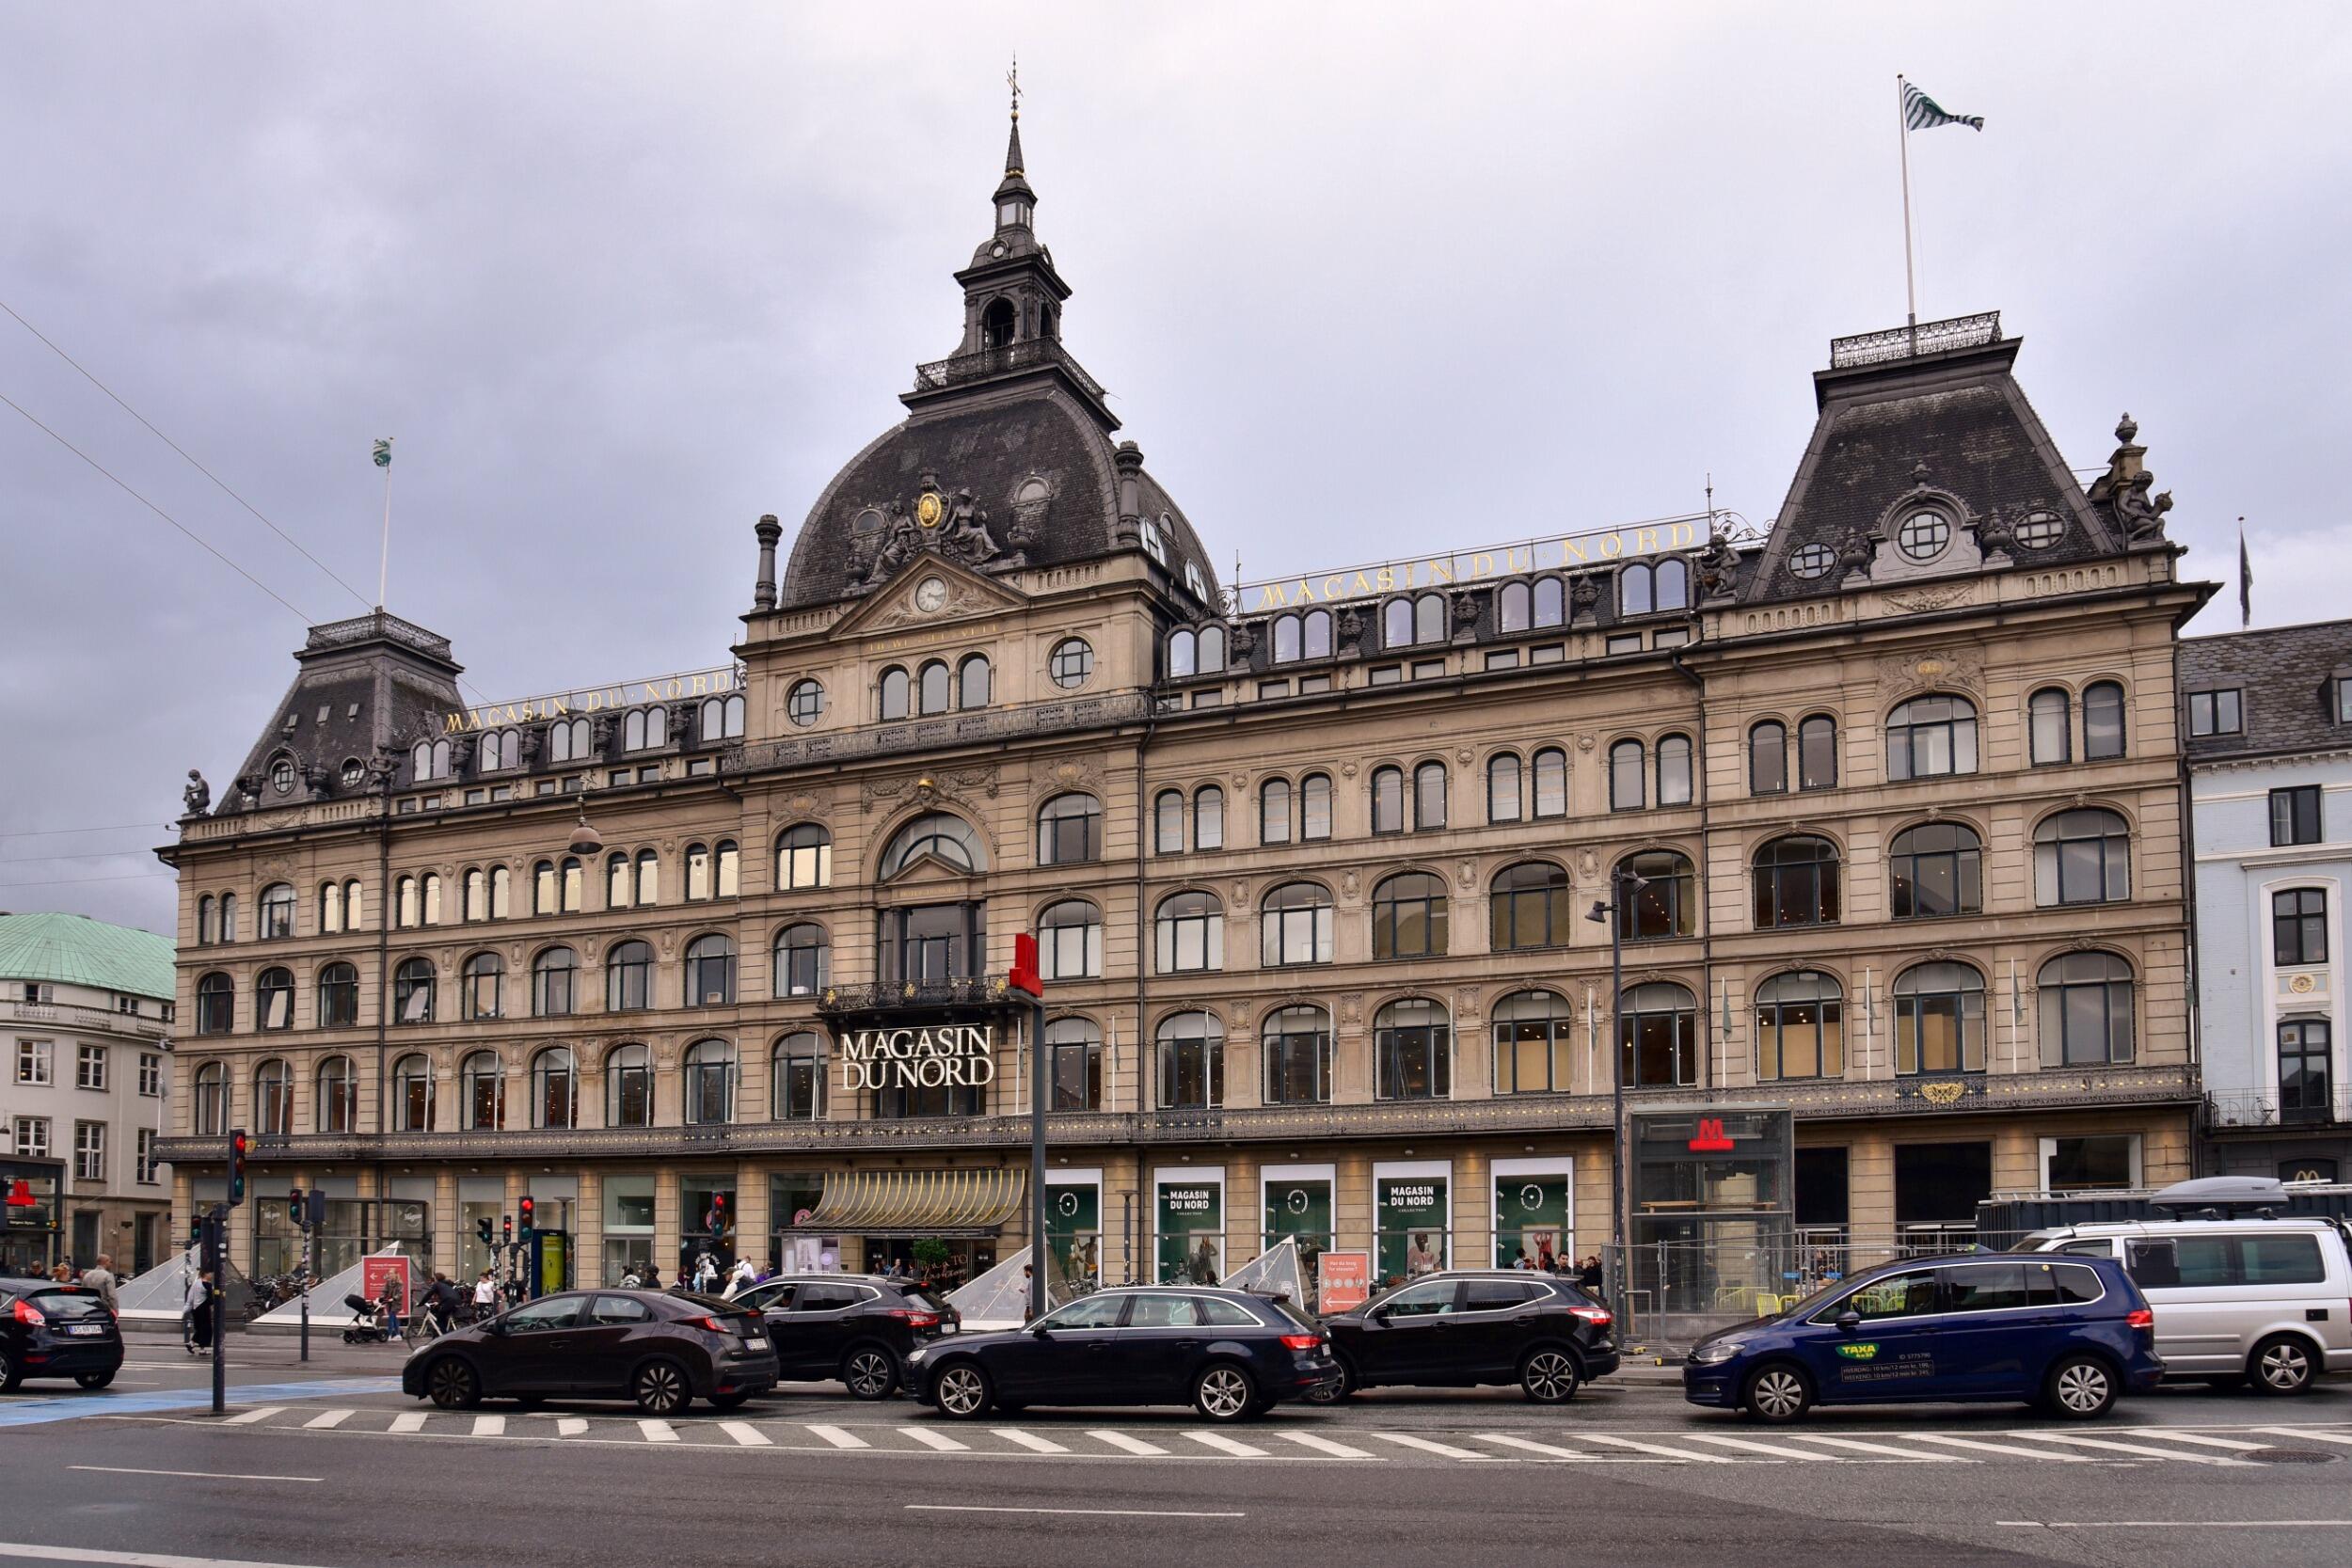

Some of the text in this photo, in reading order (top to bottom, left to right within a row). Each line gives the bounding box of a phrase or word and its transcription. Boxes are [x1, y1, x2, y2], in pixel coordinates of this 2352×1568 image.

[1255, 523, 1694, 611] MAGASIN DU NORD
[442, 672, 729, 735] MAGASIN DU NORD
[840, 1026, 993, 1061] MAGASIN
[841, 1056, 994, 1090] DU NORD
[1169, 1190, 1210, 1200] MAGASIN
[1391, 1186, 1434, 1196] MAGASIN
[1169, 1199, 1210, 1210] DU NORD
[1391, 1196, 1435, 1207] DU NORD
[1842, 1345, 1876, 1354] TAXA
